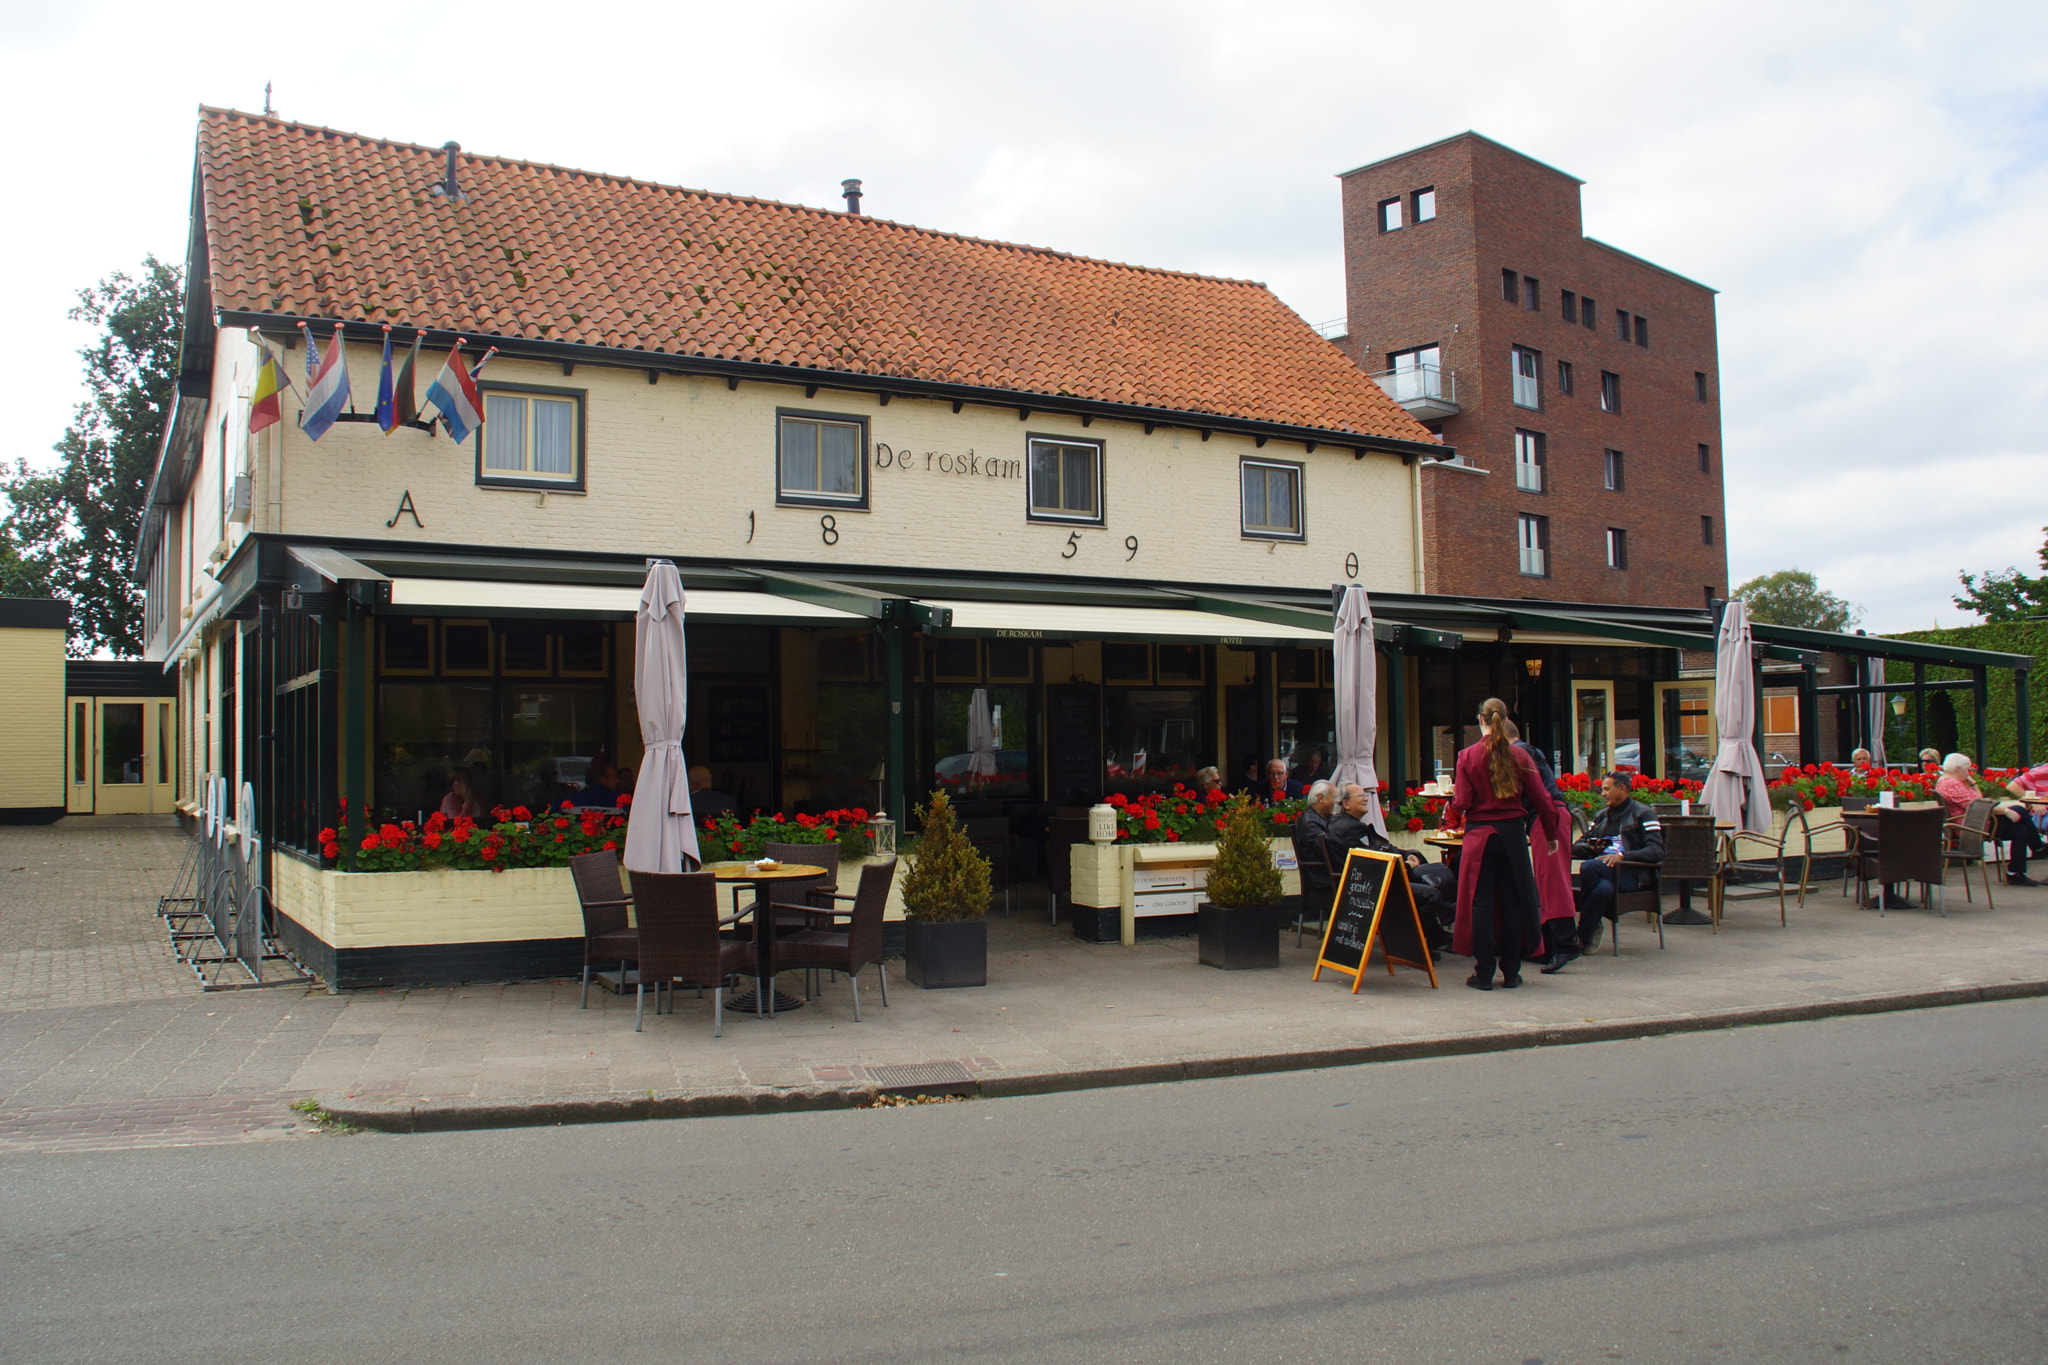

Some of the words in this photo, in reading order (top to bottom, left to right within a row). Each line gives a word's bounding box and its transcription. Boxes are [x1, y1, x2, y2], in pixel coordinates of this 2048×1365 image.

[875, 442, 914, 471] De
[925, 448, 1022, 479] roskam
[386, 489, 425, 528] A
[821, 514, 839, 546] 8
[1061, 530, 1083, 559] 5
[1125, 535, 1139, 562] 9
[996, 629, 1007, 638] DE
[1009, 629, 1042, 639] ROSKAM
[1220, 636, 1243, 645] HOTEL
[1099, 823, 1115, 831] LIKE
